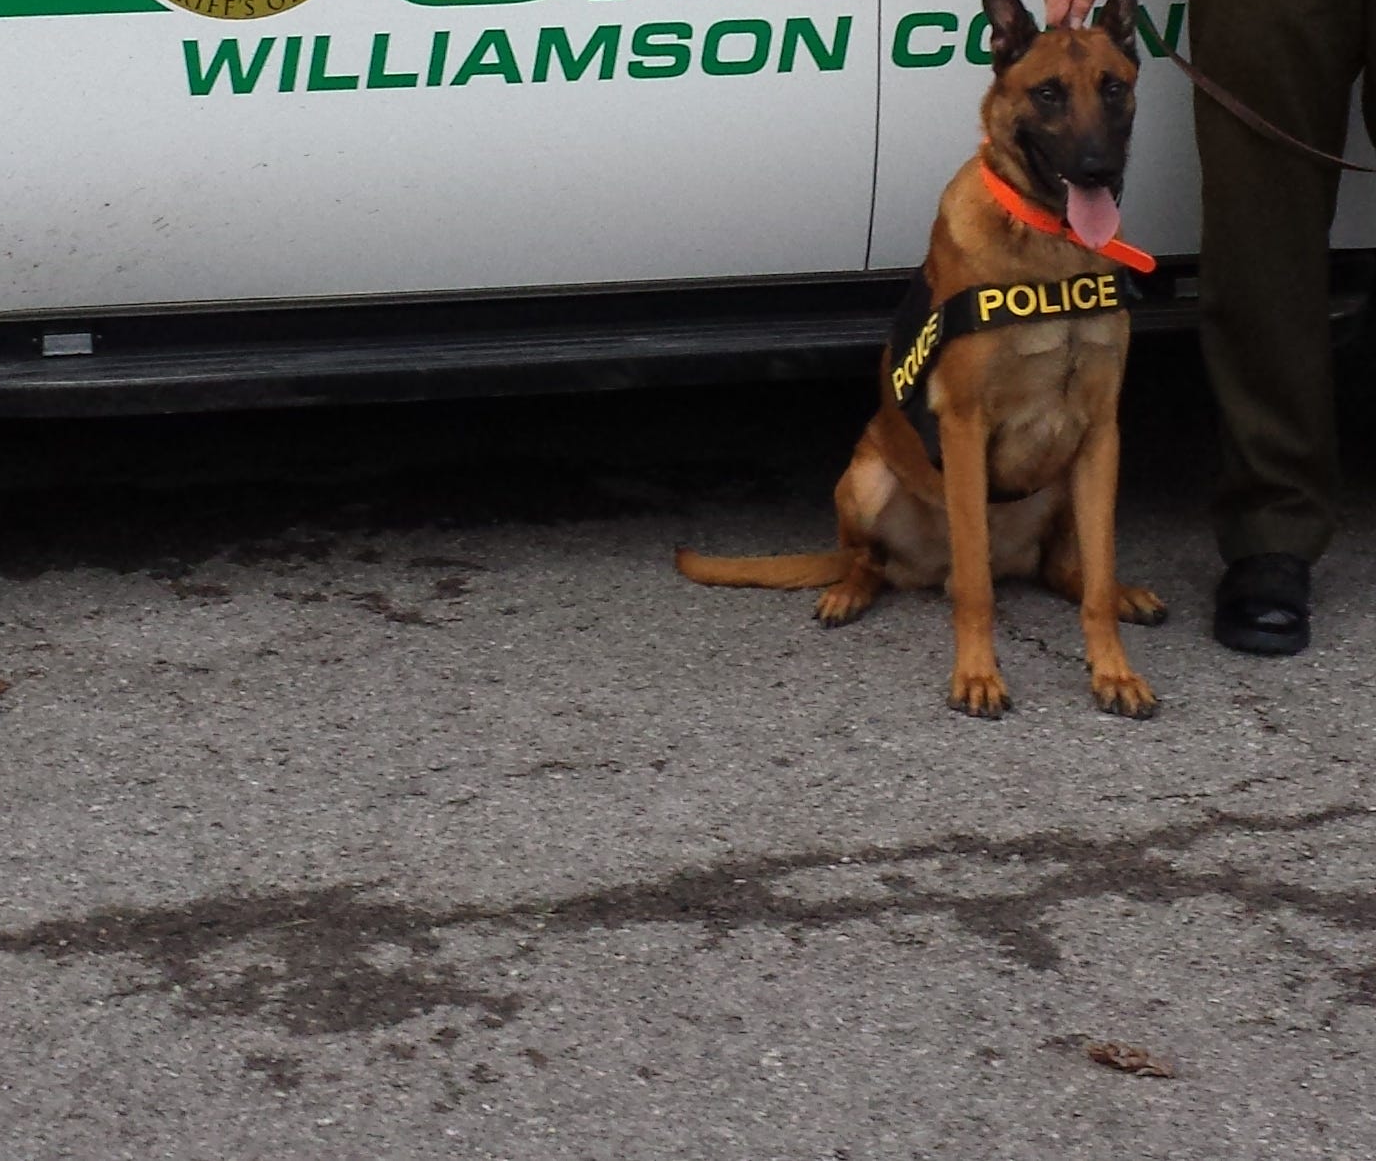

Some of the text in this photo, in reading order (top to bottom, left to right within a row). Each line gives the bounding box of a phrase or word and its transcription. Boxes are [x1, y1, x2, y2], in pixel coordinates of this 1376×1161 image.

[182, 15, 852, 96] WILLIAMSON
[978, 275, 1118, 322] POLICE
[891, 312, 939, 401] POLICE
